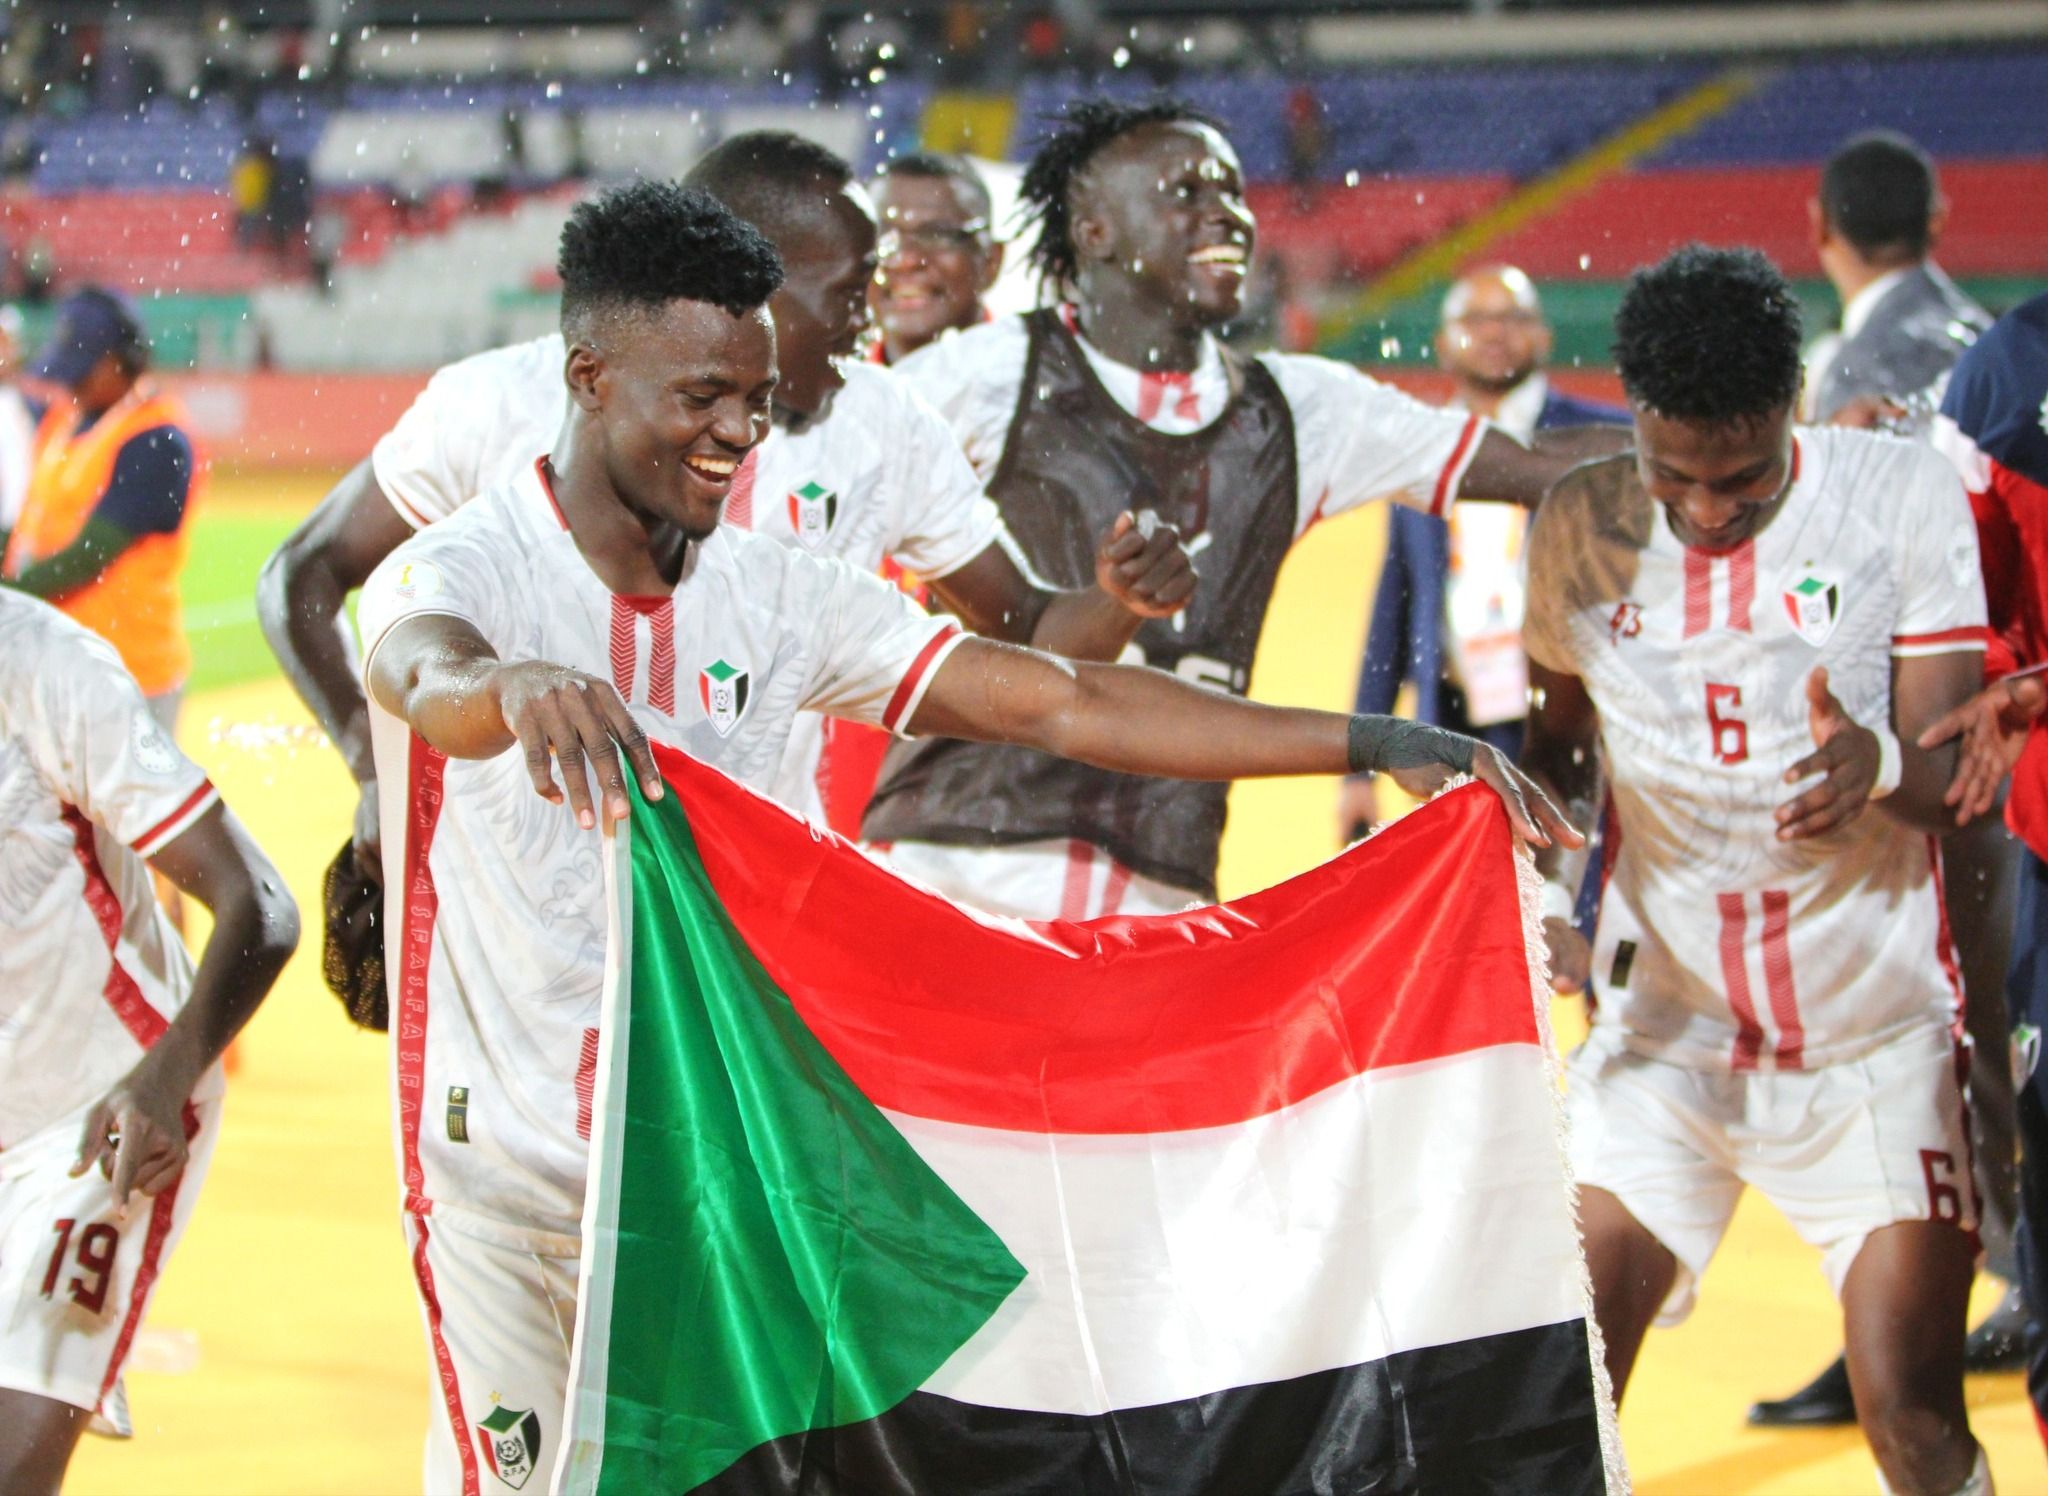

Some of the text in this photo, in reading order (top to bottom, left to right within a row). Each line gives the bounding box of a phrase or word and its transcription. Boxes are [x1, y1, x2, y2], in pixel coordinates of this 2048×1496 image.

[1706, 682, 1748, 767] 6
[402, 976, 424, 1040] S.F.A
[1919, 1148, 1961, 1224] 6
[40, 1218, 118, 1316] 19
